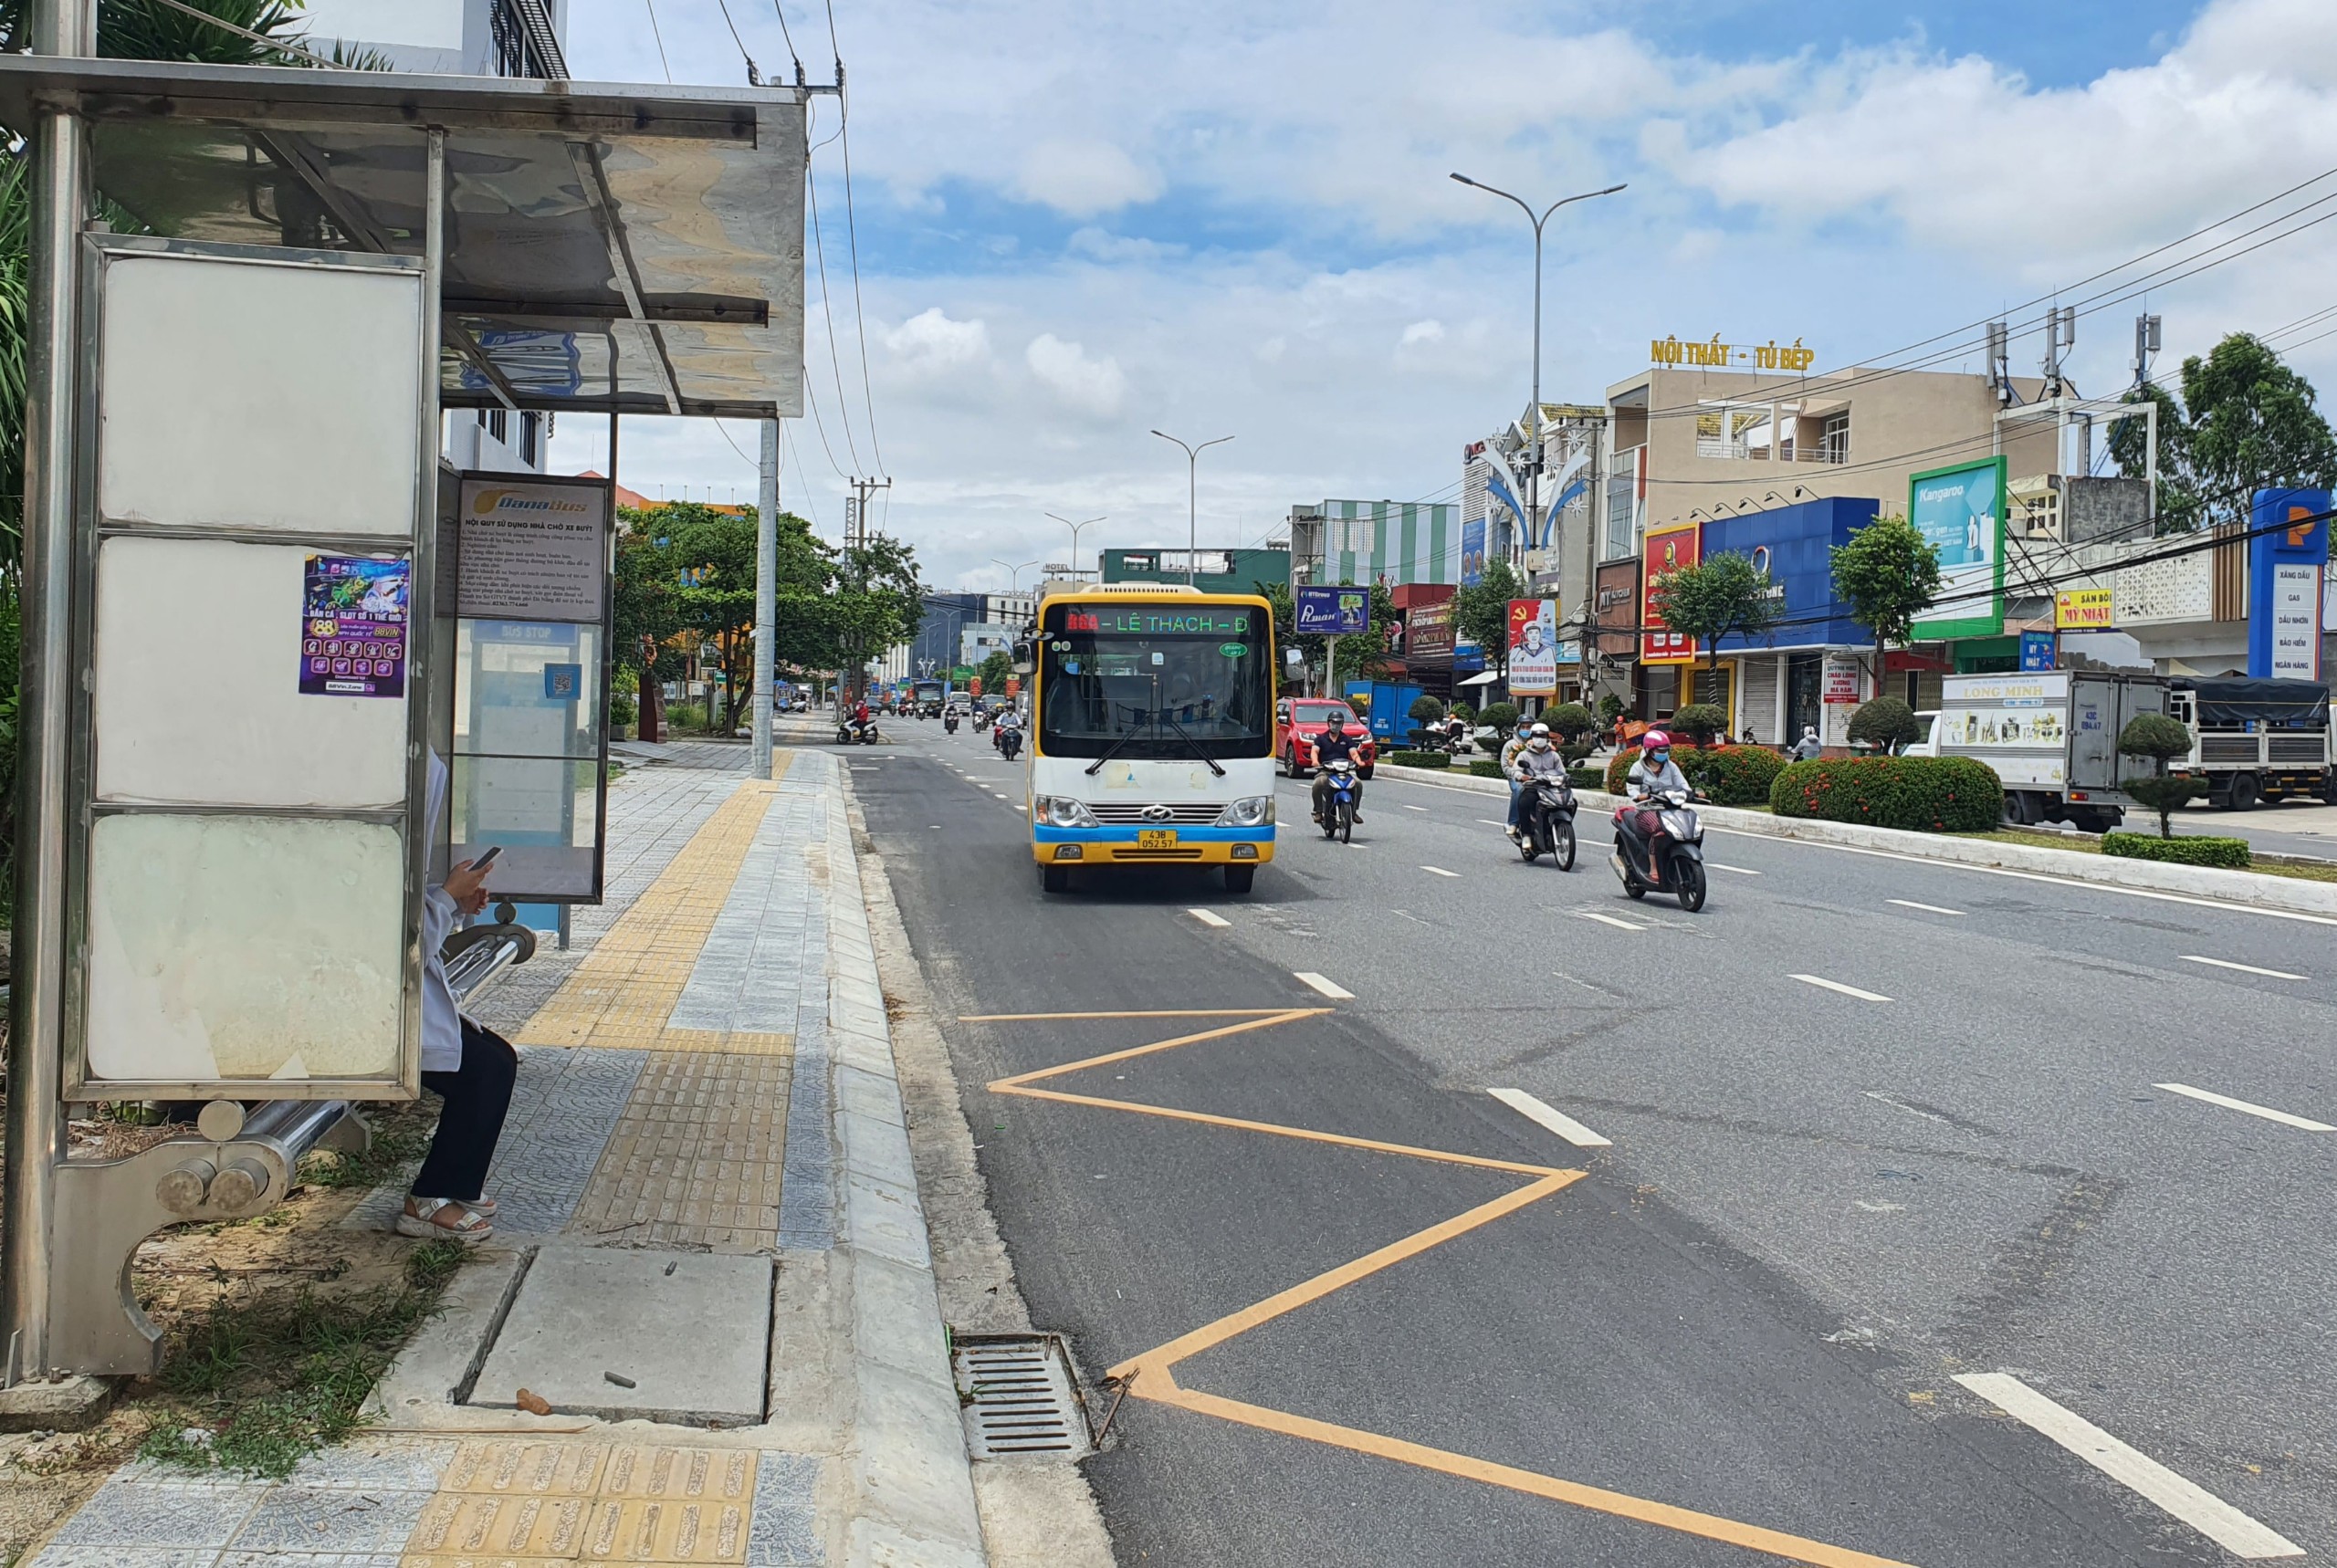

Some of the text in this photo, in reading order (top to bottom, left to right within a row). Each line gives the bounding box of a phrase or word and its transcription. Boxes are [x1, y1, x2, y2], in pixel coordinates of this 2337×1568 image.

[1651, 334, 1682, 370] NỘI
[1685, 332, 1730, 366] THẤT
[1755, 340, 1777, 369] TỦ
[1780, 337, 1814, 371] BẾP
[1919, 486, 1964, 503] Kangaroo
[498, 497, 588, 512] DanaBus
[466, 517, 478, 528] NỘI
[2081, 604, 2111, 624] NHẬT
[1116, 612, 1141, 632] LÊ
[502, 626, 551, 638] BUS STOP
[1964, 685, 2043, 698] LONG MINH
[1148, 831, 1166, 839] 43B
[1142, 839, 1173, 848] 052.57
